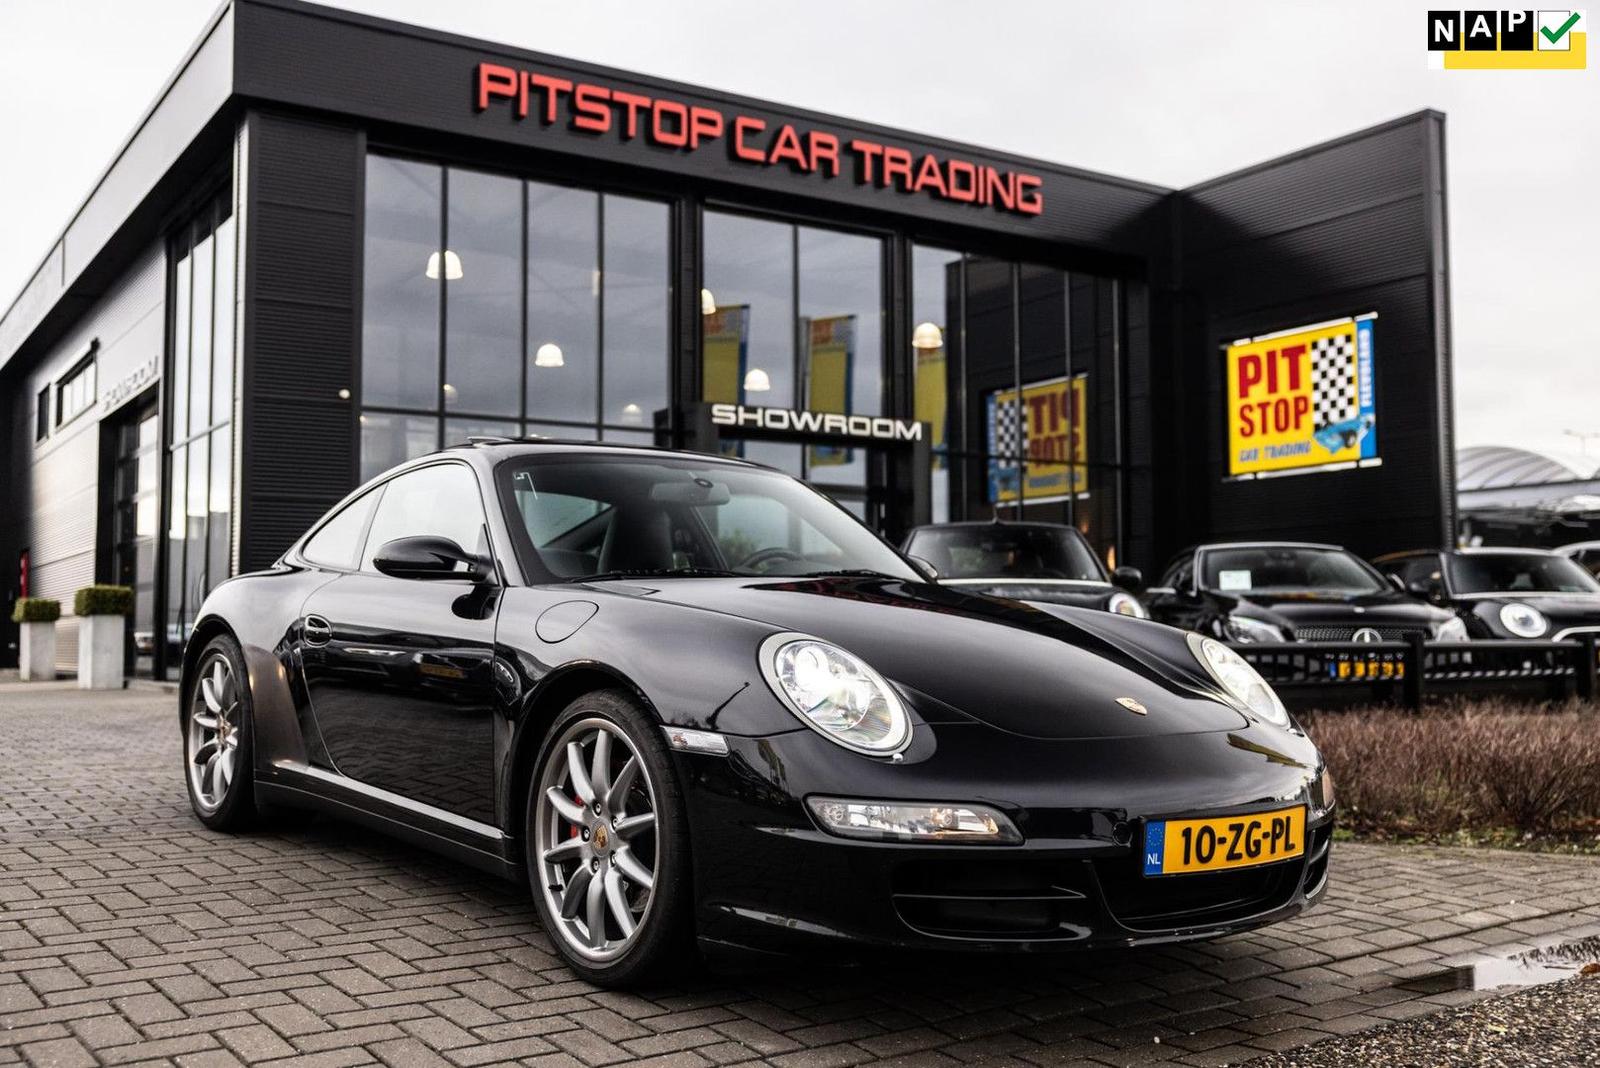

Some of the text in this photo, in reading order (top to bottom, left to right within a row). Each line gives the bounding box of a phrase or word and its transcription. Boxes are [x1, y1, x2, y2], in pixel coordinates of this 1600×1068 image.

[479, 62, 1042, 215] PITSTOP CAR TRADING
[1238, 344, 1307, 399] PIT
[711, 403, 922, 441] SHOWROOM
[1239, 395, 1309, 438] STOP
[1147, 853, 1161, 865] NL
[1181, 815, 1296, 866] 10-ZG-PL
